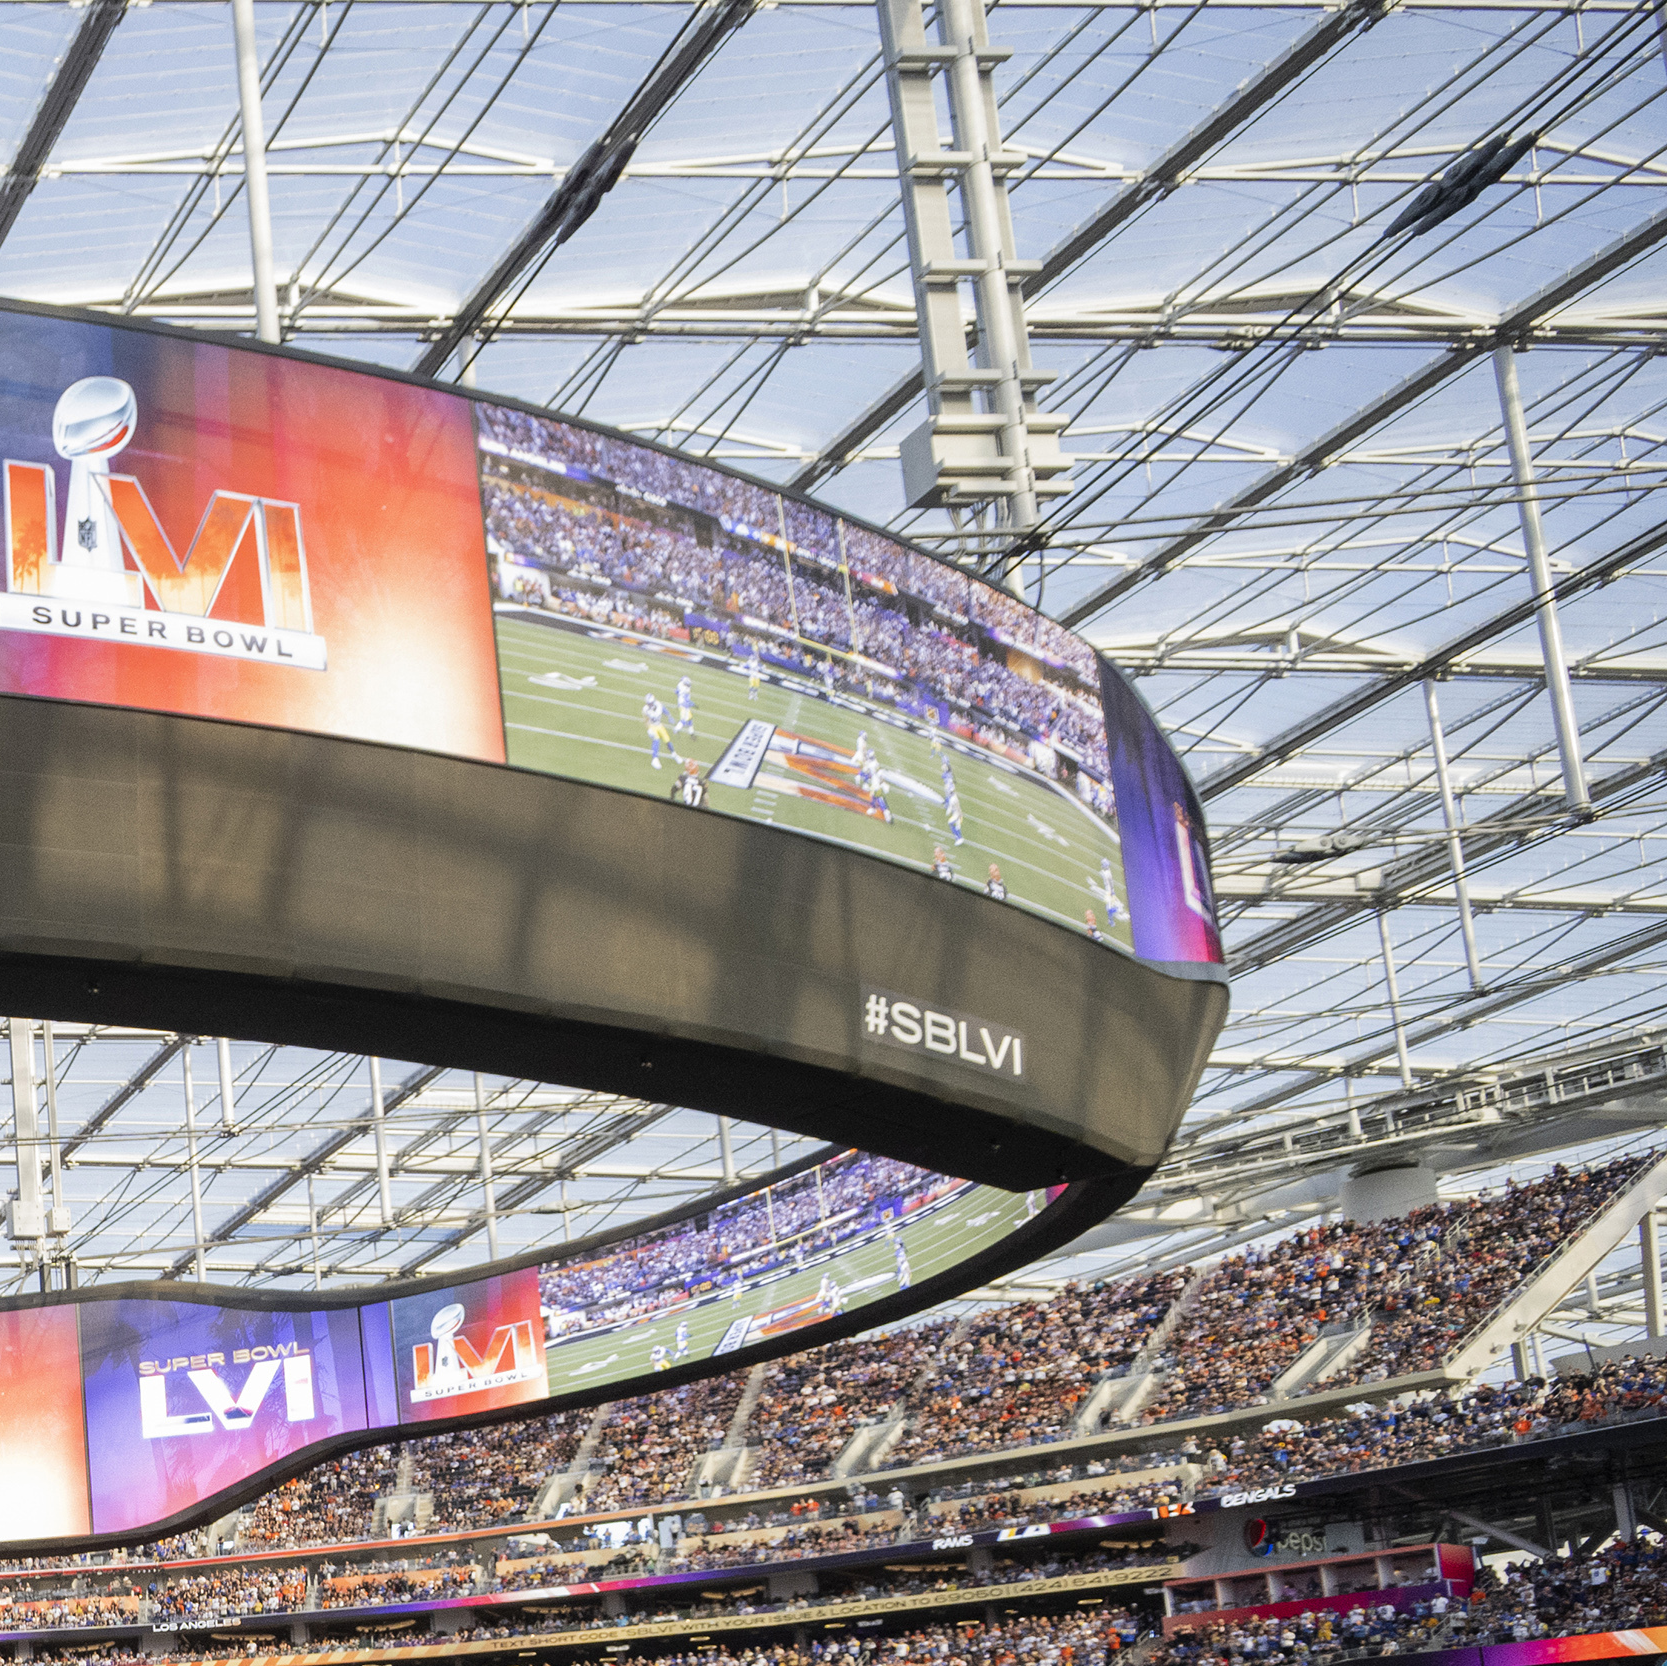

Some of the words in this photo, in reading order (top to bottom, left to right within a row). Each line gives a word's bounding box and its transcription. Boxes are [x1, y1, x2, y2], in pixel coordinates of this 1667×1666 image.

[33, 604, 167, 640] SUPER
[187, 624, 294, 659] BOWL
[865, 993, 1021, 1076] #SBLVI
[139, 1352, 226, 1376] SUPER
[231, 1341, 310, 1367] BOWL
[138, 1354, 316, 1440] LVI
[425, 1384, 473, 1399] SUPER
[484, 1371, 528, 1387] BOWL
[1219, 1484, 1297, 1508] BENGALS
[932, 1534, 974, 1550] RAMS
[153, 1623, 181, 1633] LOS
[181, 1618, 242, 1631] ANGELES
